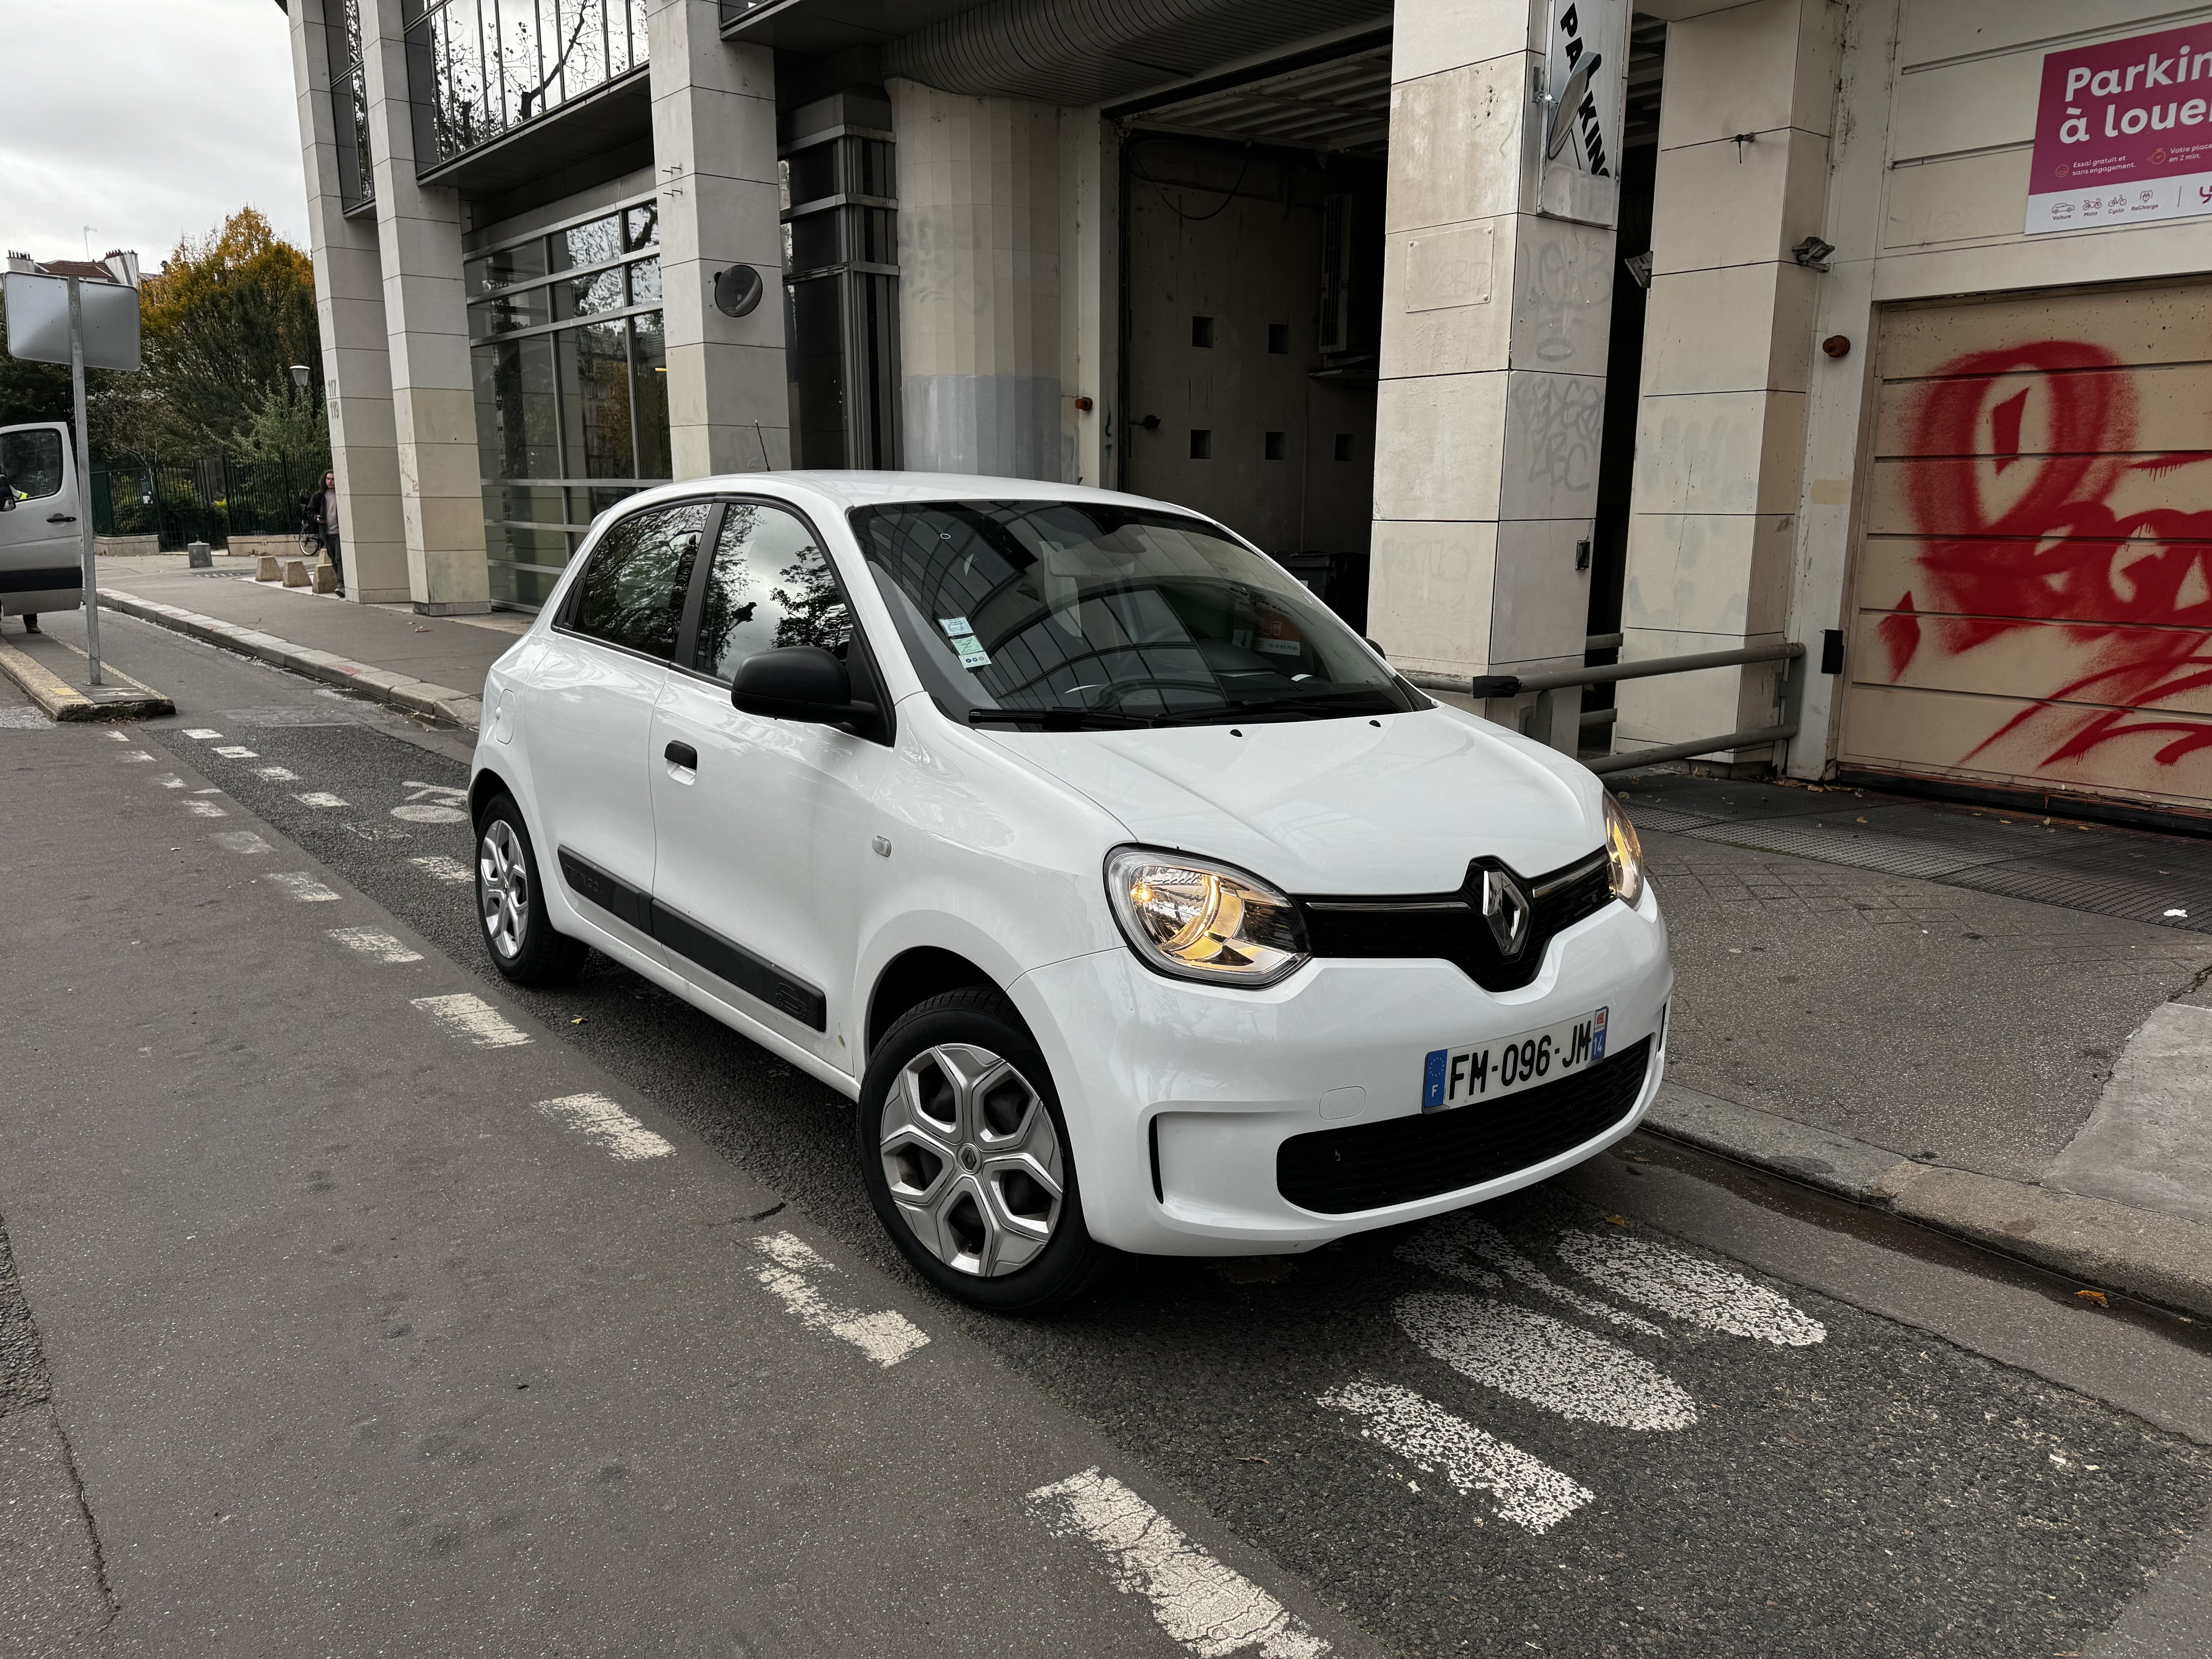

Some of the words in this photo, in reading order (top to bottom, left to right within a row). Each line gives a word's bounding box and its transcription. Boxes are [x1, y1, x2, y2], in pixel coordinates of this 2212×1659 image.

[1560, 2, 1610, 178] PAKIN
[2059, 106, 2090, 144] à
[2104, 98, 2212, 137] loue
[2170, 146, 2190, 154] Votre
[2090, 162, 2136, 174] engagement.
[2092, 156, 2117, 167] gratuit
[328, 379, 336, 397] 117
[330, 401, 339, 419] 119
[1594, 1034, 1603, 1055] 14
[1449, 1020, 1592, 1101] FM-096-JM
[1431, 1084, 1438, 1097] F
